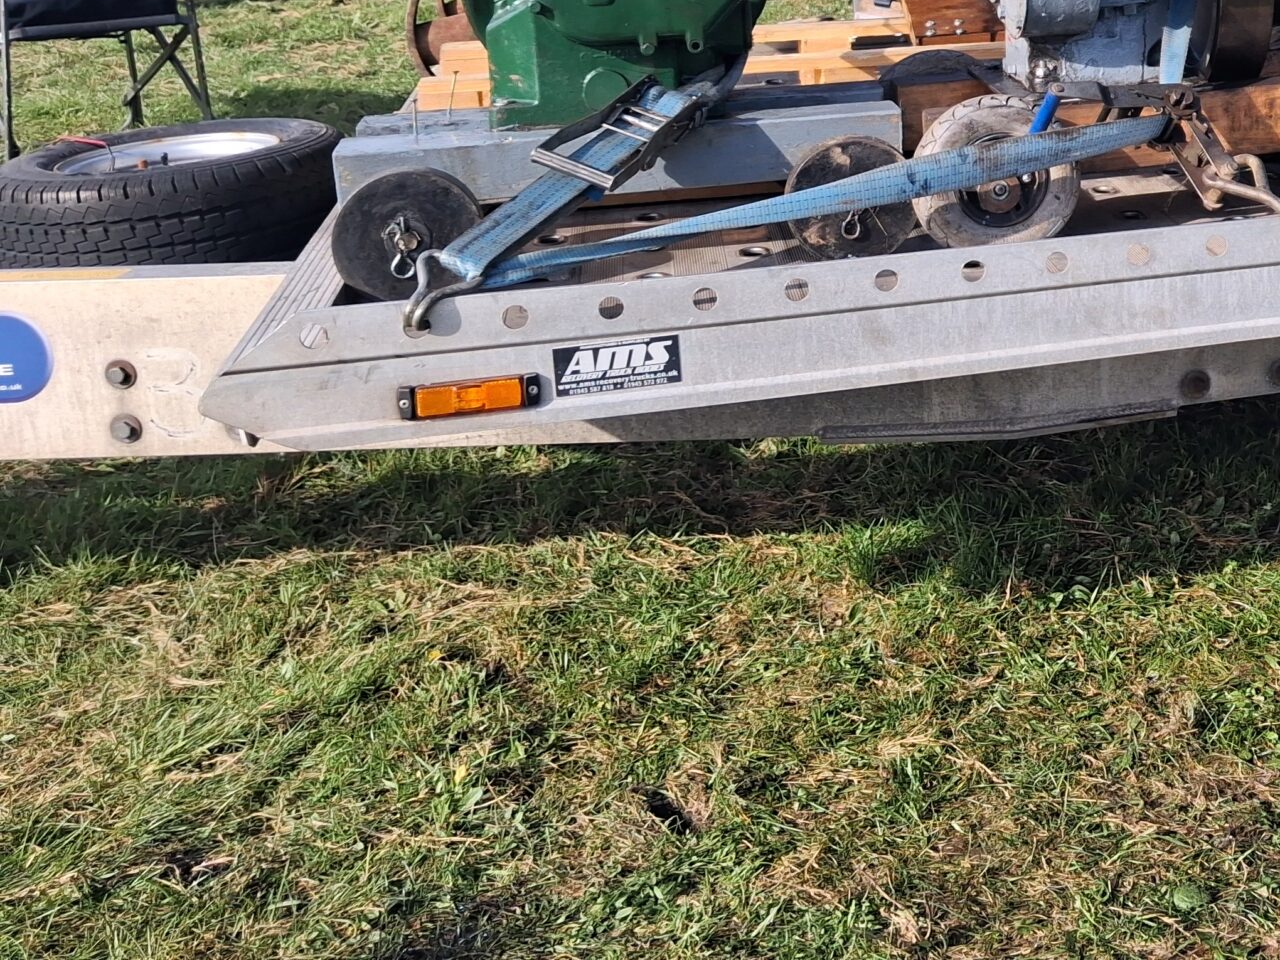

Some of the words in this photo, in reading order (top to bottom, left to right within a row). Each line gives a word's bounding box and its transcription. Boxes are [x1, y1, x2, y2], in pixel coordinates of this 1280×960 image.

[563, 339, 673, 376] AMS
[560, 370, 606, 384] RECOVERY
[605, 367, 635, 378] TRUCK
